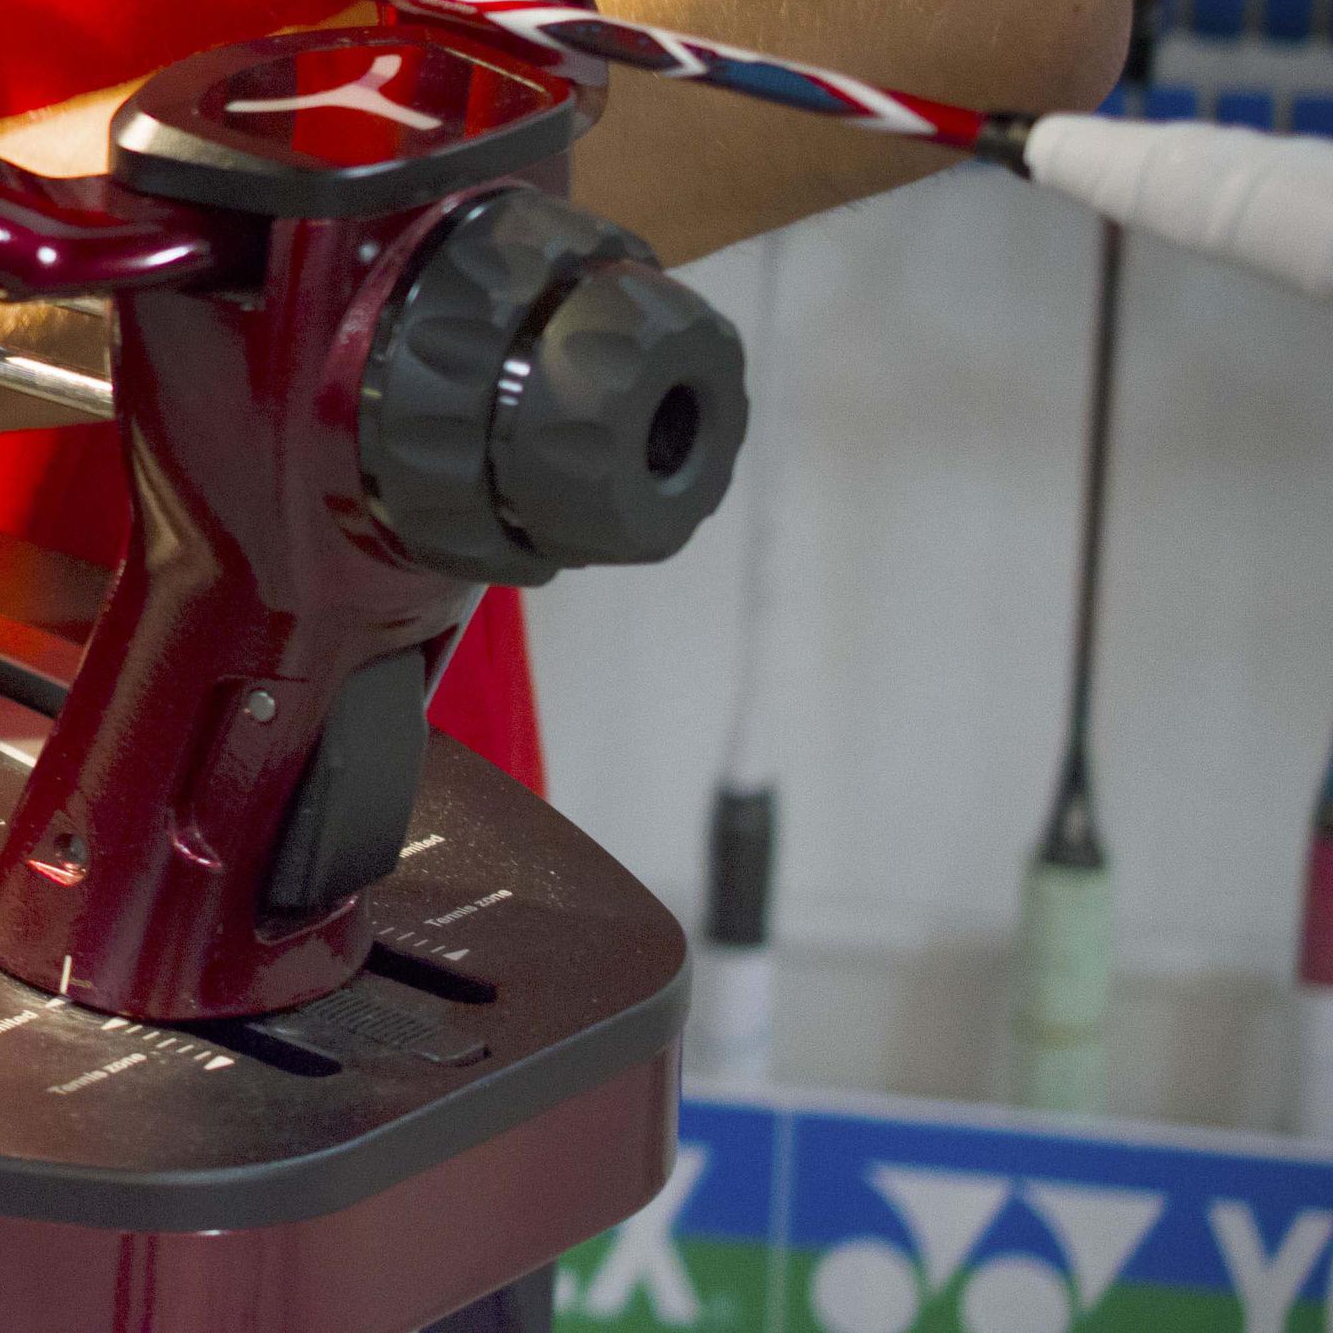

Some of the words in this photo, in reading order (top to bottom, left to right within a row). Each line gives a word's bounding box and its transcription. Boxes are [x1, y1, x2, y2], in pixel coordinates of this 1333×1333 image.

[423, 905, 478, 927] Tennis
[474, 889, 513, 907] zone
[45, 1070, 108, 1094] Tennis
[103, 1052, 147, 1073] zone
